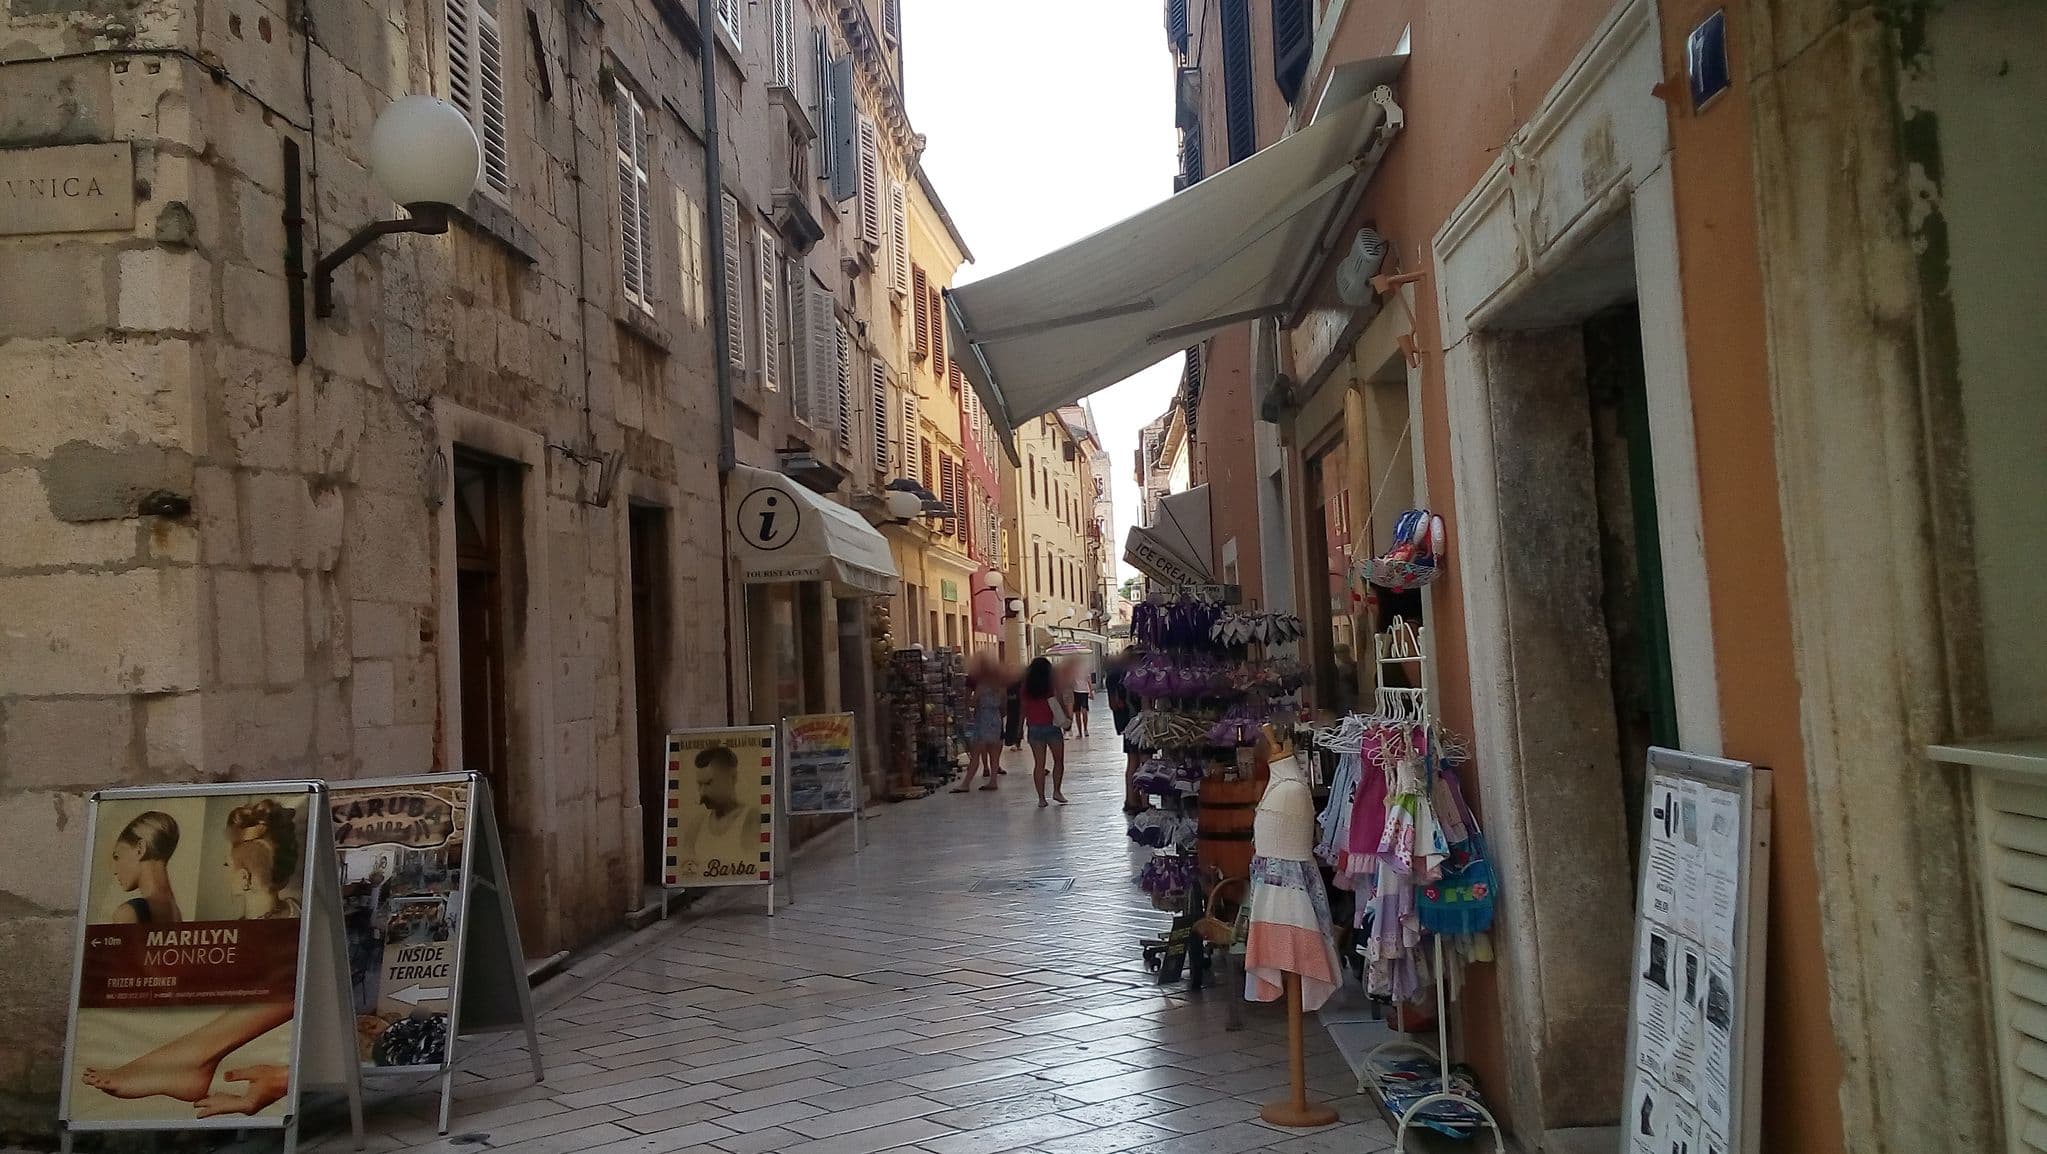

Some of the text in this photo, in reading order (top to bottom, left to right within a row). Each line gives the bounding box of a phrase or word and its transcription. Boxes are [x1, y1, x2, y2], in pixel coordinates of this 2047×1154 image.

[745, 568, 821, 578] TOURIST AGENCY
[1135, 543, 1197, 586] ICE CREAM
[703, 858, 757, 878] Barba
[104, 936, 122, 946] 10m
[146, 928, 239, 947] MARILYN
[143, 947, 237, 966] MONROE
[396, 947, 445, 963] INSIDE
[388, 963, 450, 980] TERRACE
[107, 977, 135, 988] FRIZER
[144, 976, 177, 987] PEDIKER
